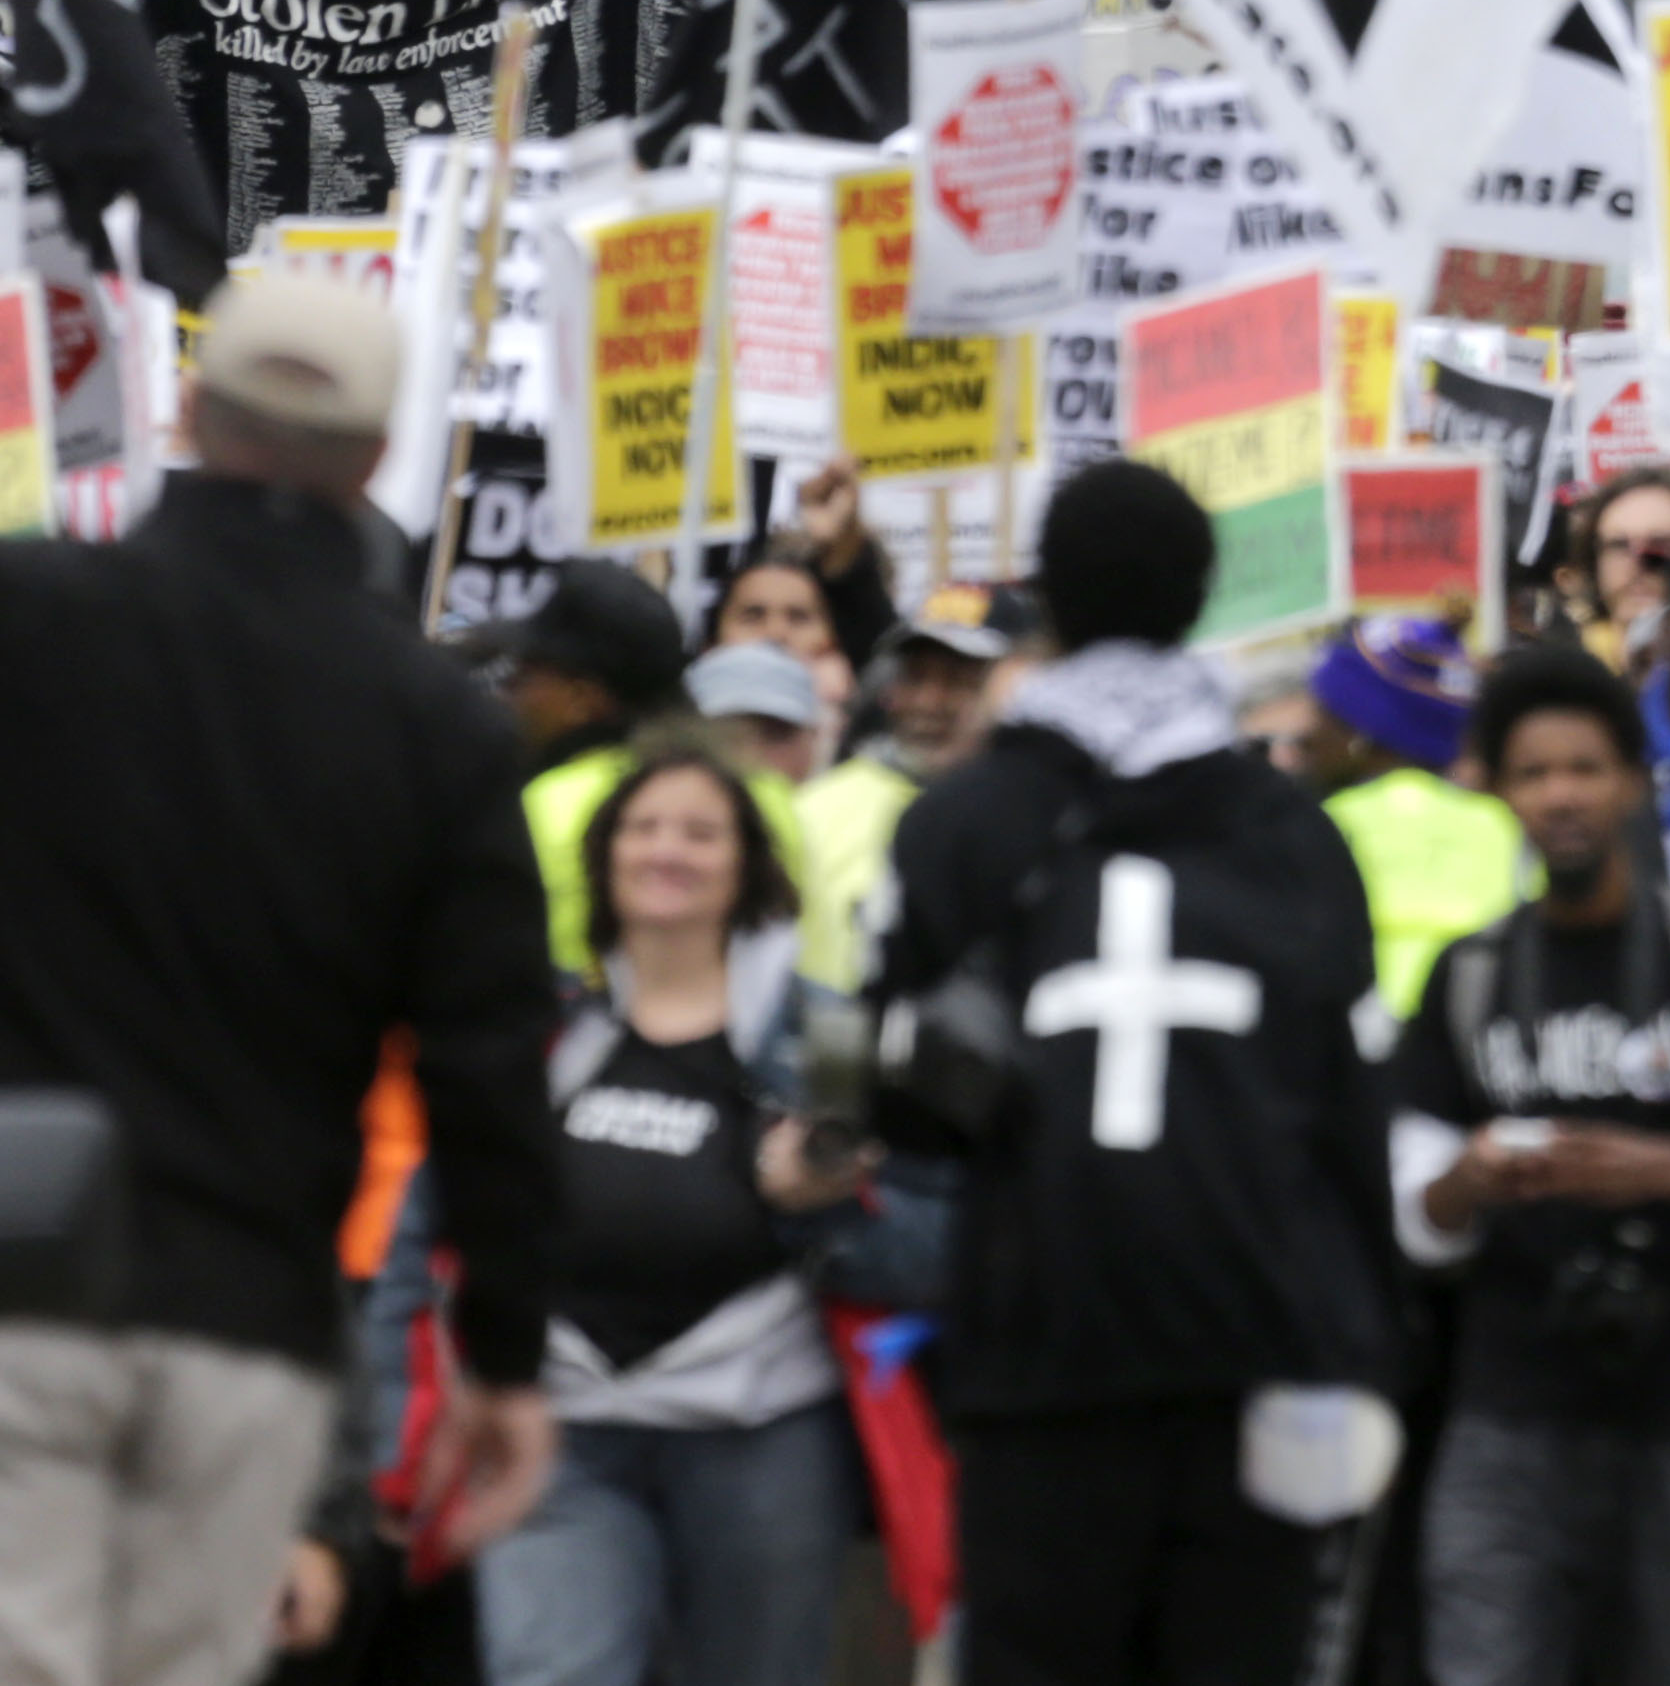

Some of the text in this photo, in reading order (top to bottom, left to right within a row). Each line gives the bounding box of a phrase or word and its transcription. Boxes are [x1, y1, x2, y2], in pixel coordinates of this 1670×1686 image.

[213, 19, 288, 68] killed
[289, 39, 329, 80] by
[337, 47, 392, 75] law
[1085, 146, 1226, 187] stice
